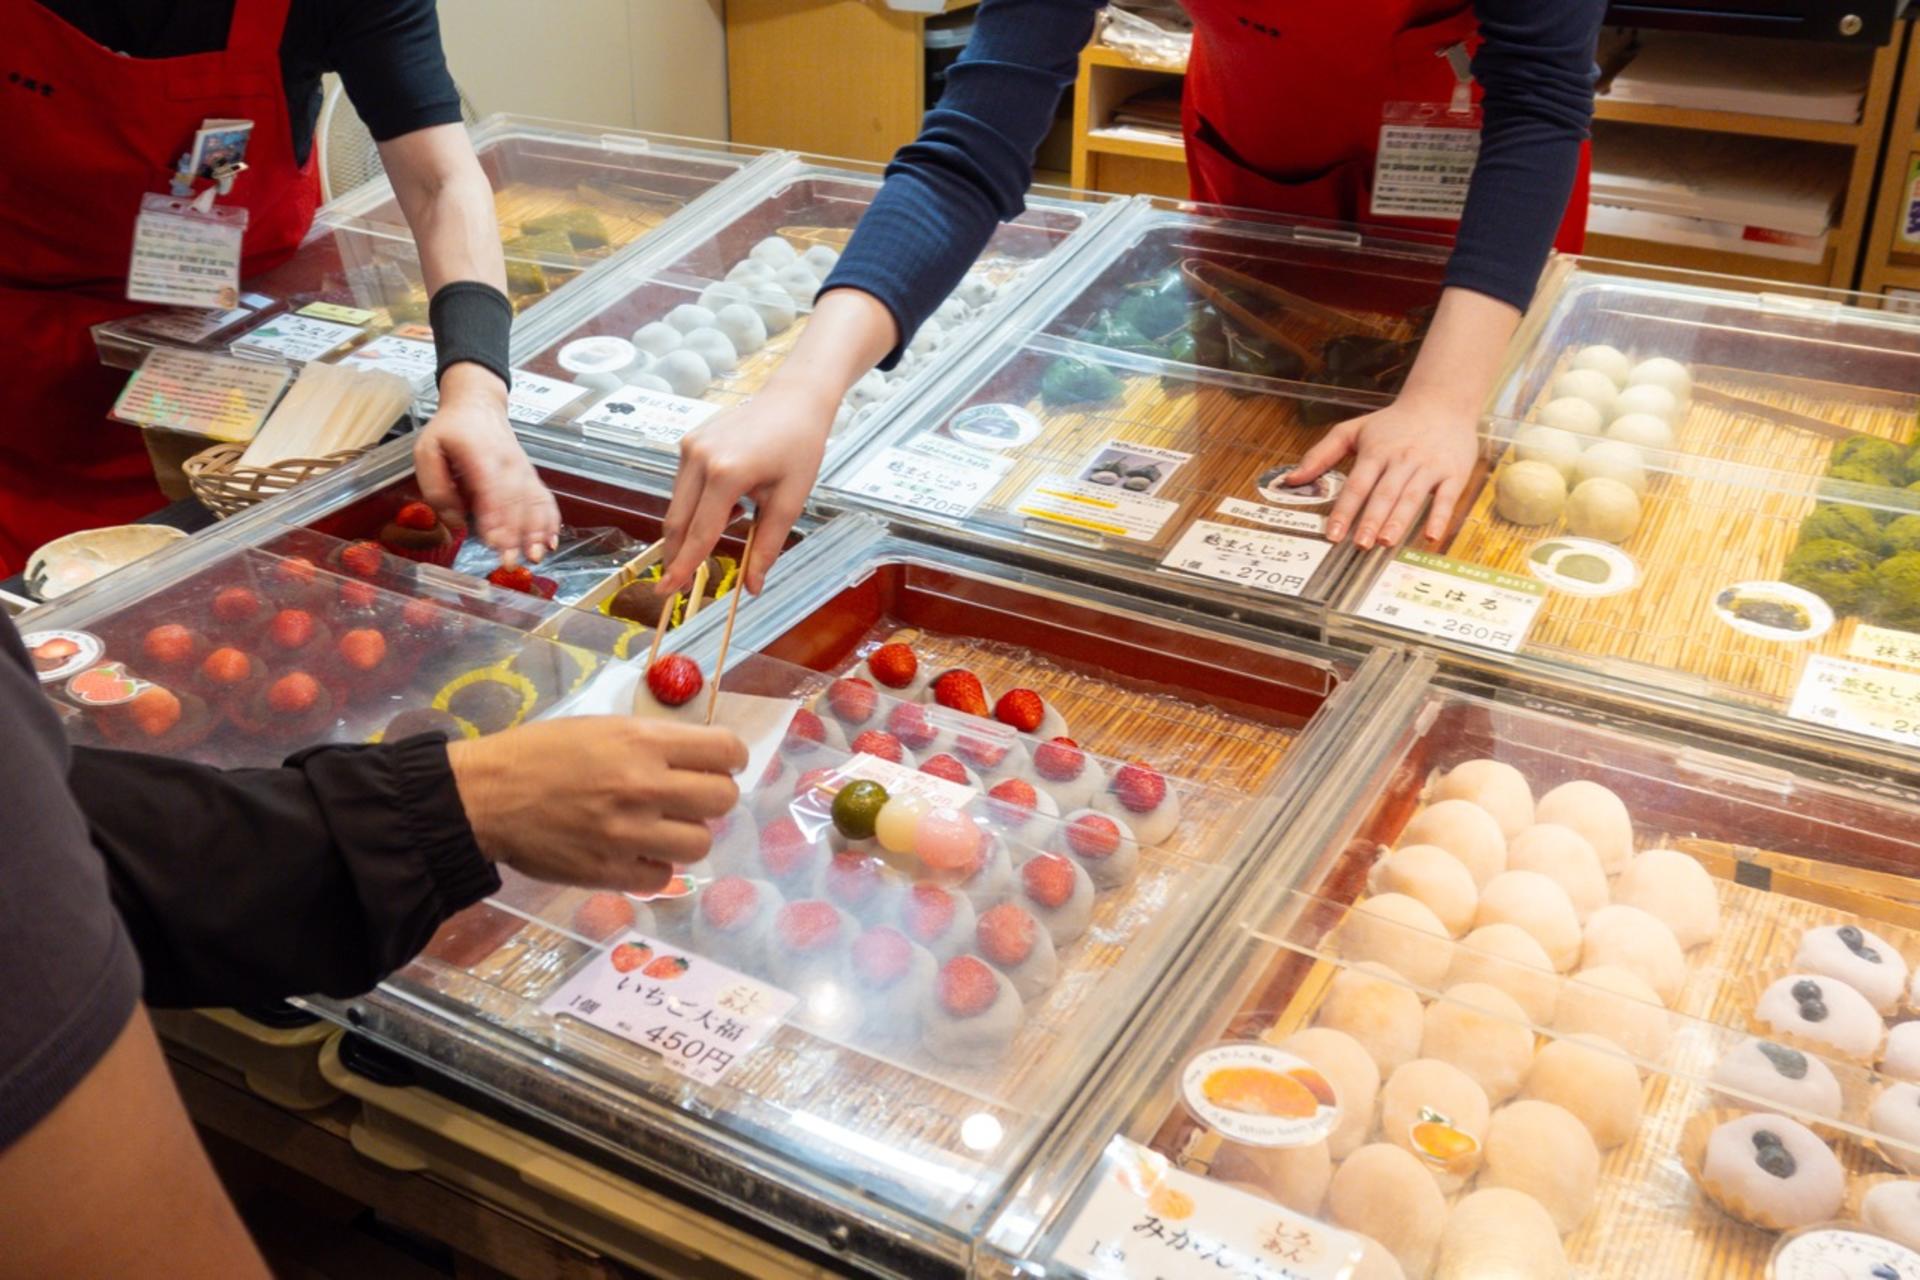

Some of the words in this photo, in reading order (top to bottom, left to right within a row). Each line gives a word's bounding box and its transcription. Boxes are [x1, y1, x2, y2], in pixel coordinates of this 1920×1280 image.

[510, 402, 548, 422] 70円
[909, 492, 968, 516] 270円
[1229, 505, 1265, 521] Black
[1268, 516, 1319, 531] sesame
[1236, 565, 1306, 591] 270円
[1403, 550, 1452, 571] Matcha
[1457, 564, 1491, 581] bean
[1495, 575, 1538, 592] paste
[1413, 580, 1500, 612] こはる
[1376, 603, 1400, 618] 1個
[1442, 617, 1514, 648] 260円
[717, 996, 748, 1016] あん
[732, 984, 761, 1003] こし
[616, 975, 748, 1043] いちご大福
[568, 994, 603, 1017] 1個
[645, 1023, 736, 1074] 450円
[1274, 1219, 1315, 1247] しろ
[1261, 1238, 1306, 1265] あん
